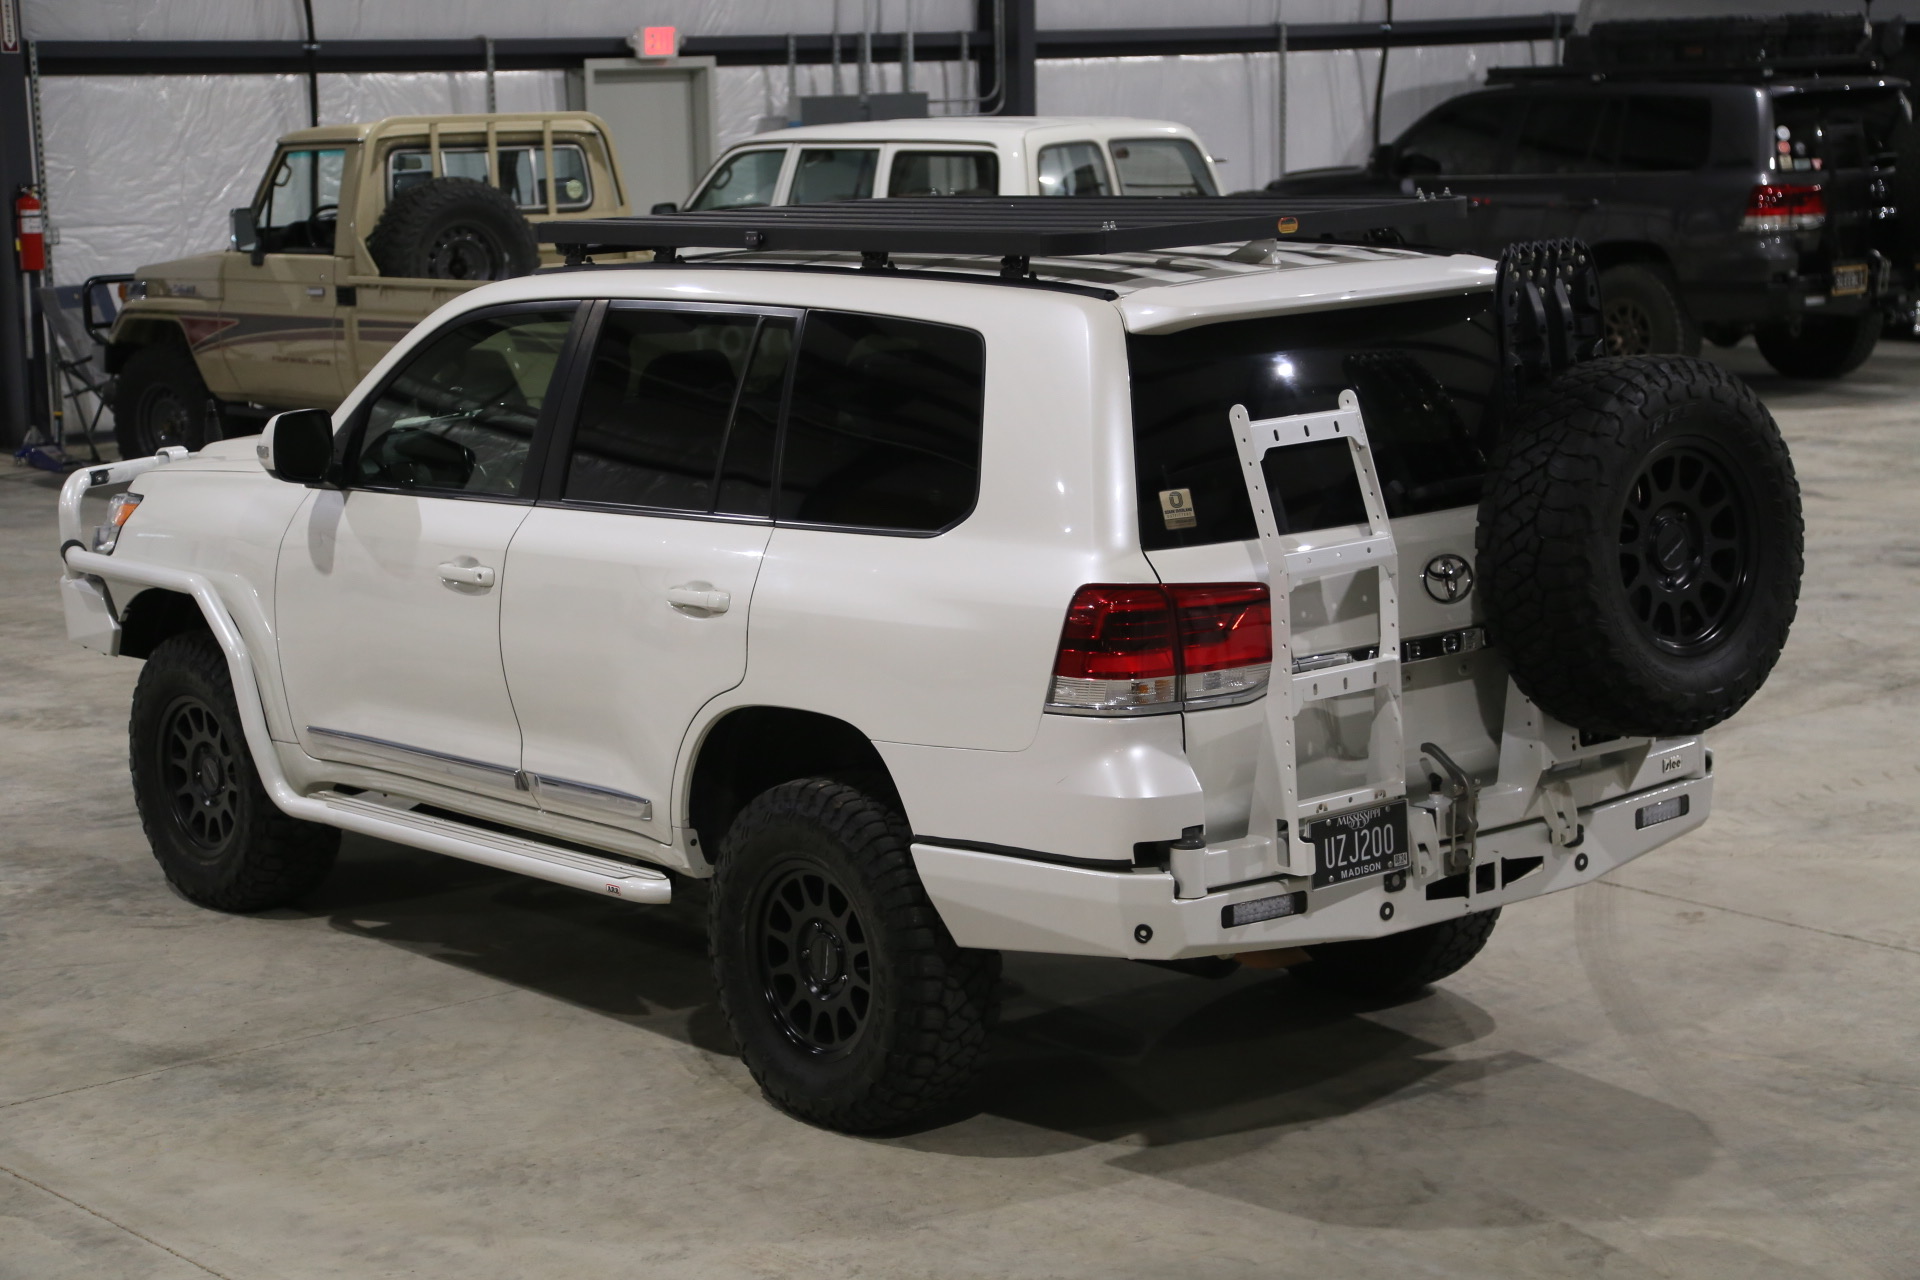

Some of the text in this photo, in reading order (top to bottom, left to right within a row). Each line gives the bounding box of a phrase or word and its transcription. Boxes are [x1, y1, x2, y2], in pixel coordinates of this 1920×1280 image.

[1336, 808, 1380, 829] MISSISSIPPI
[1325, 824, 1394, 868] UZJ200
[1340, 861, 1381, 879] MADISON
